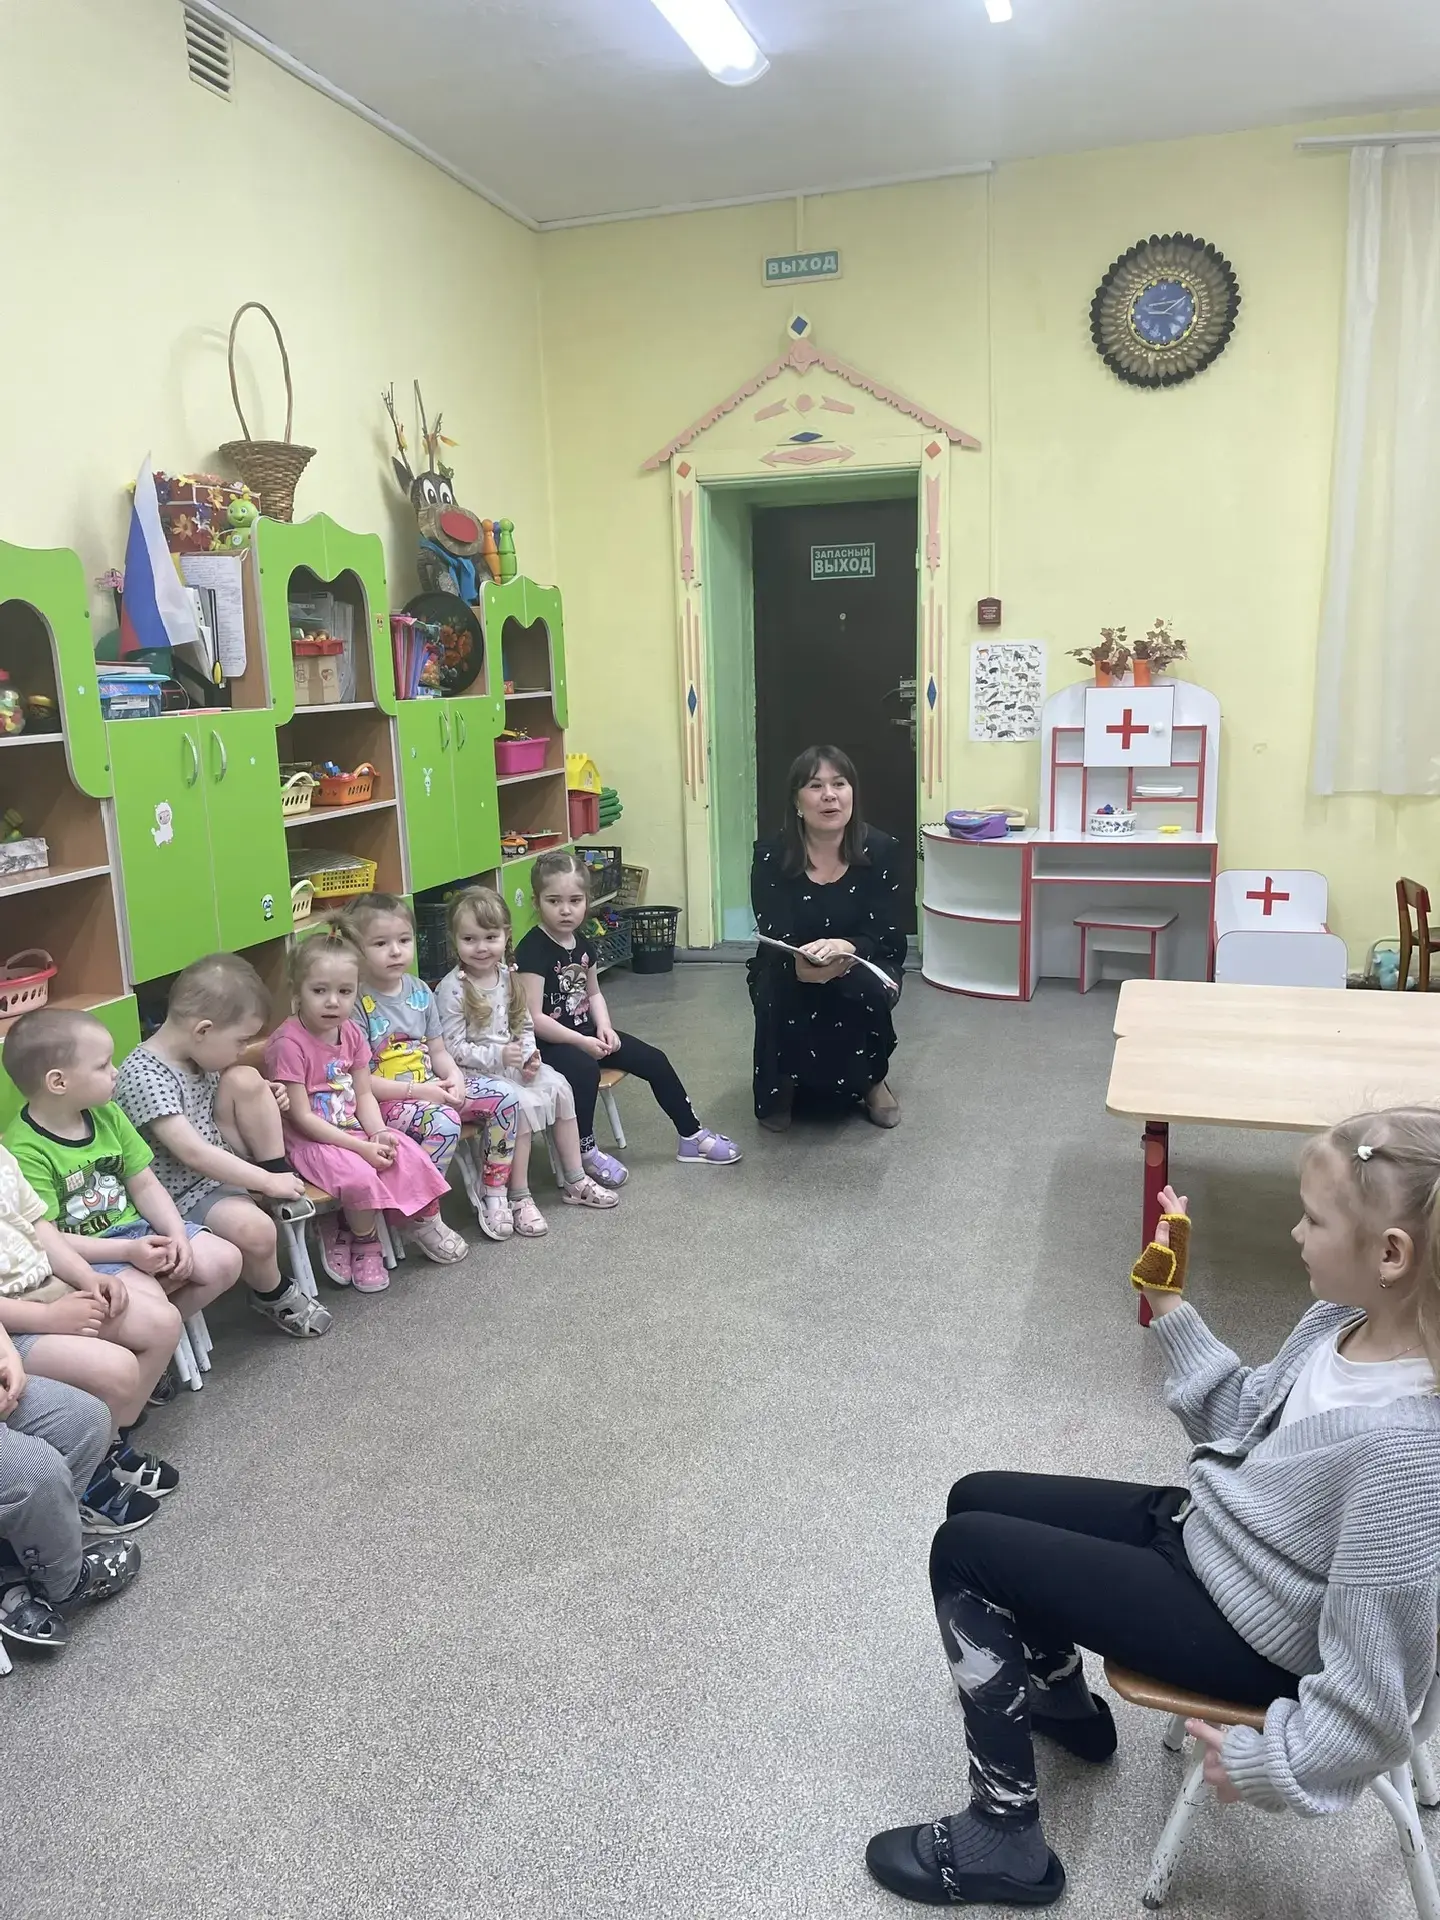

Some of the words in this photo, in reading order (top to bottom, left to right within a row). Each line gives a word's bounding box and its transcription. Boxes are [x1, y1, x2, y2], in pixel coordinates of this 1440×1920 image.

[768, 256, 837, 275] ВЫХОД
[815, 547, 871, 559] ЗАПАСНЫЙ
[815, 557, 872, 574] ВЫХОД
